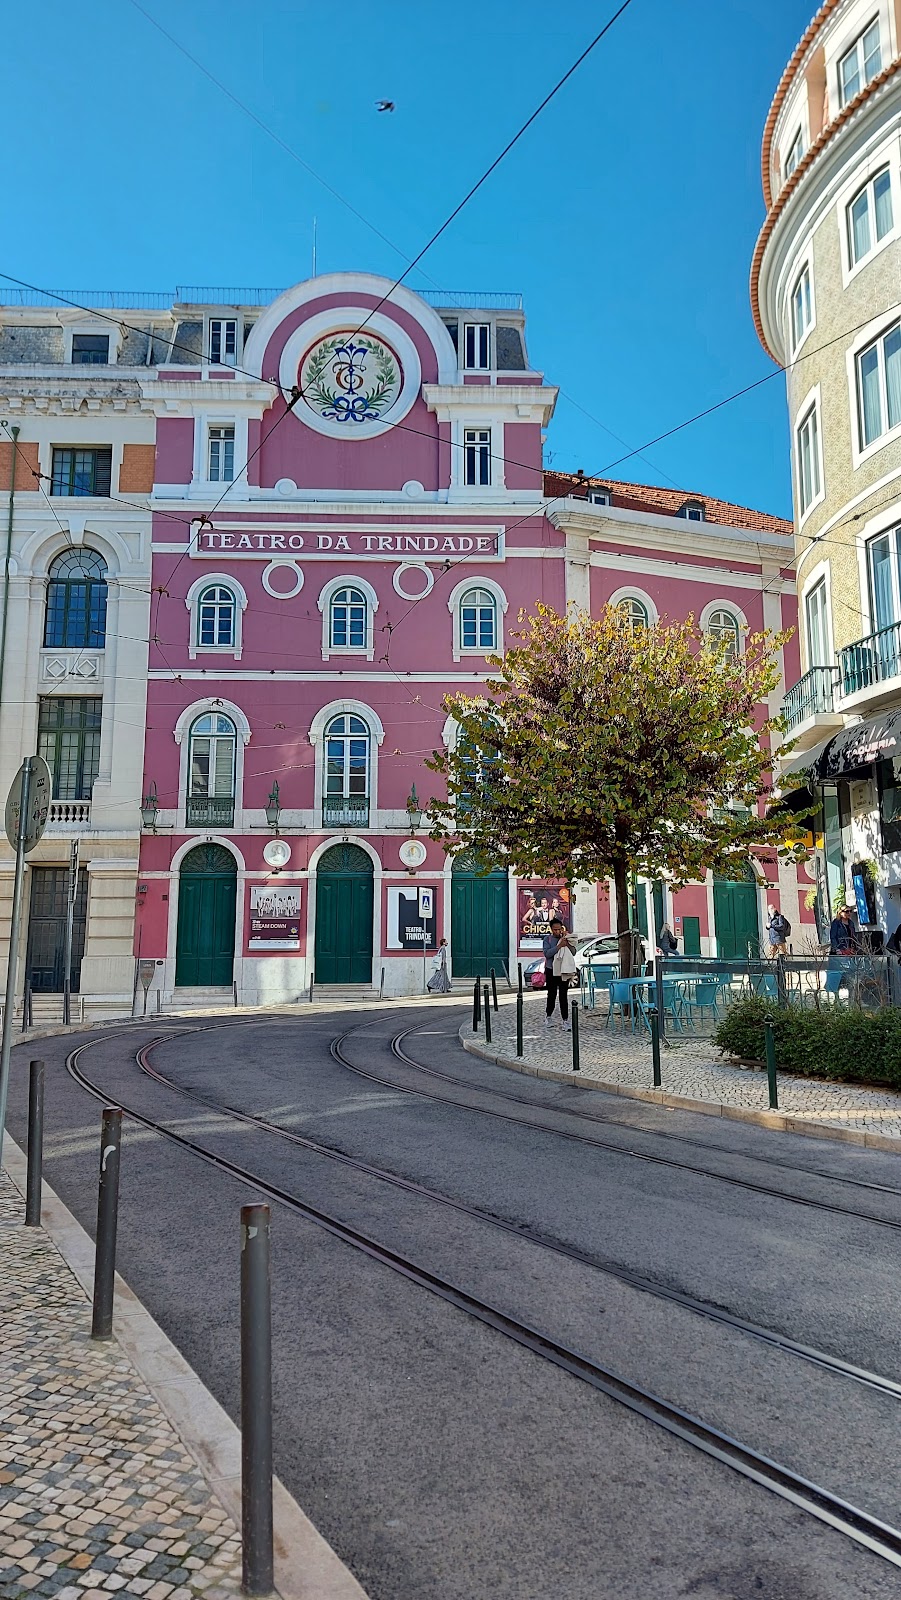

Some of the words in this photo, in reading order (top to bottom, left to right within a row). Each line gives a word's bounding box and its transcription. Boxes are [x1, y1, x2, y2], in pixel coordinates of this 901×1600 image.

[203, 533, 304, 549] TEATRO
[316, 535, 352, 551] DA
[360, 535, 492, 552] TRINDADE
[846, 736, 897, 759] TAQUERIA
